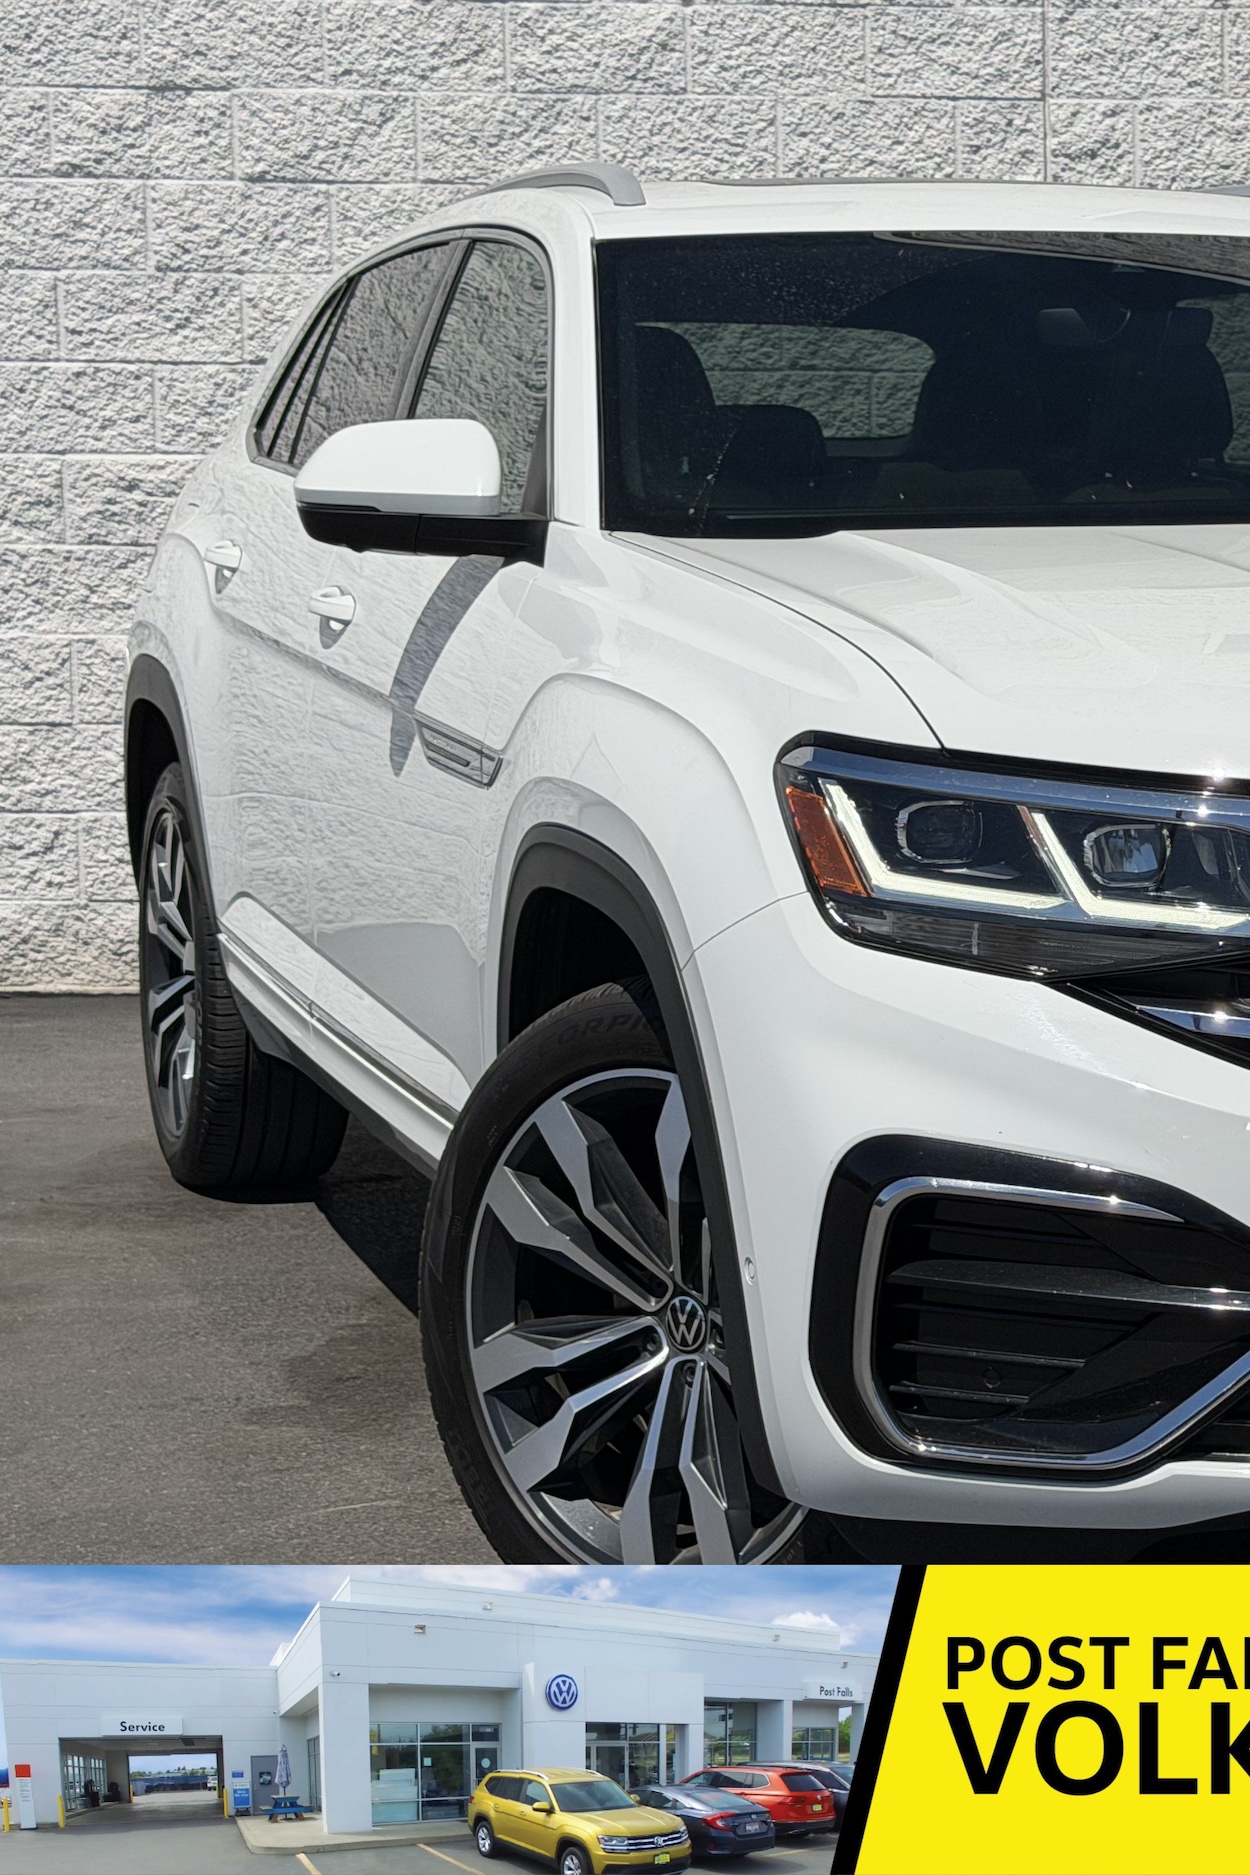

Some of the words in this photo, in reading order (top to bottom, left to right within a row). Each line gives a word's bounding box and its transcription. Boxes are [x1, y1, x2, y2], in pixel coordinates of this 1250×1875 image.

[819, 1686, 834, 1697] Post
[837, 1687, 853, 1697] Falls
[120, 1721, 165, 1732] Service
